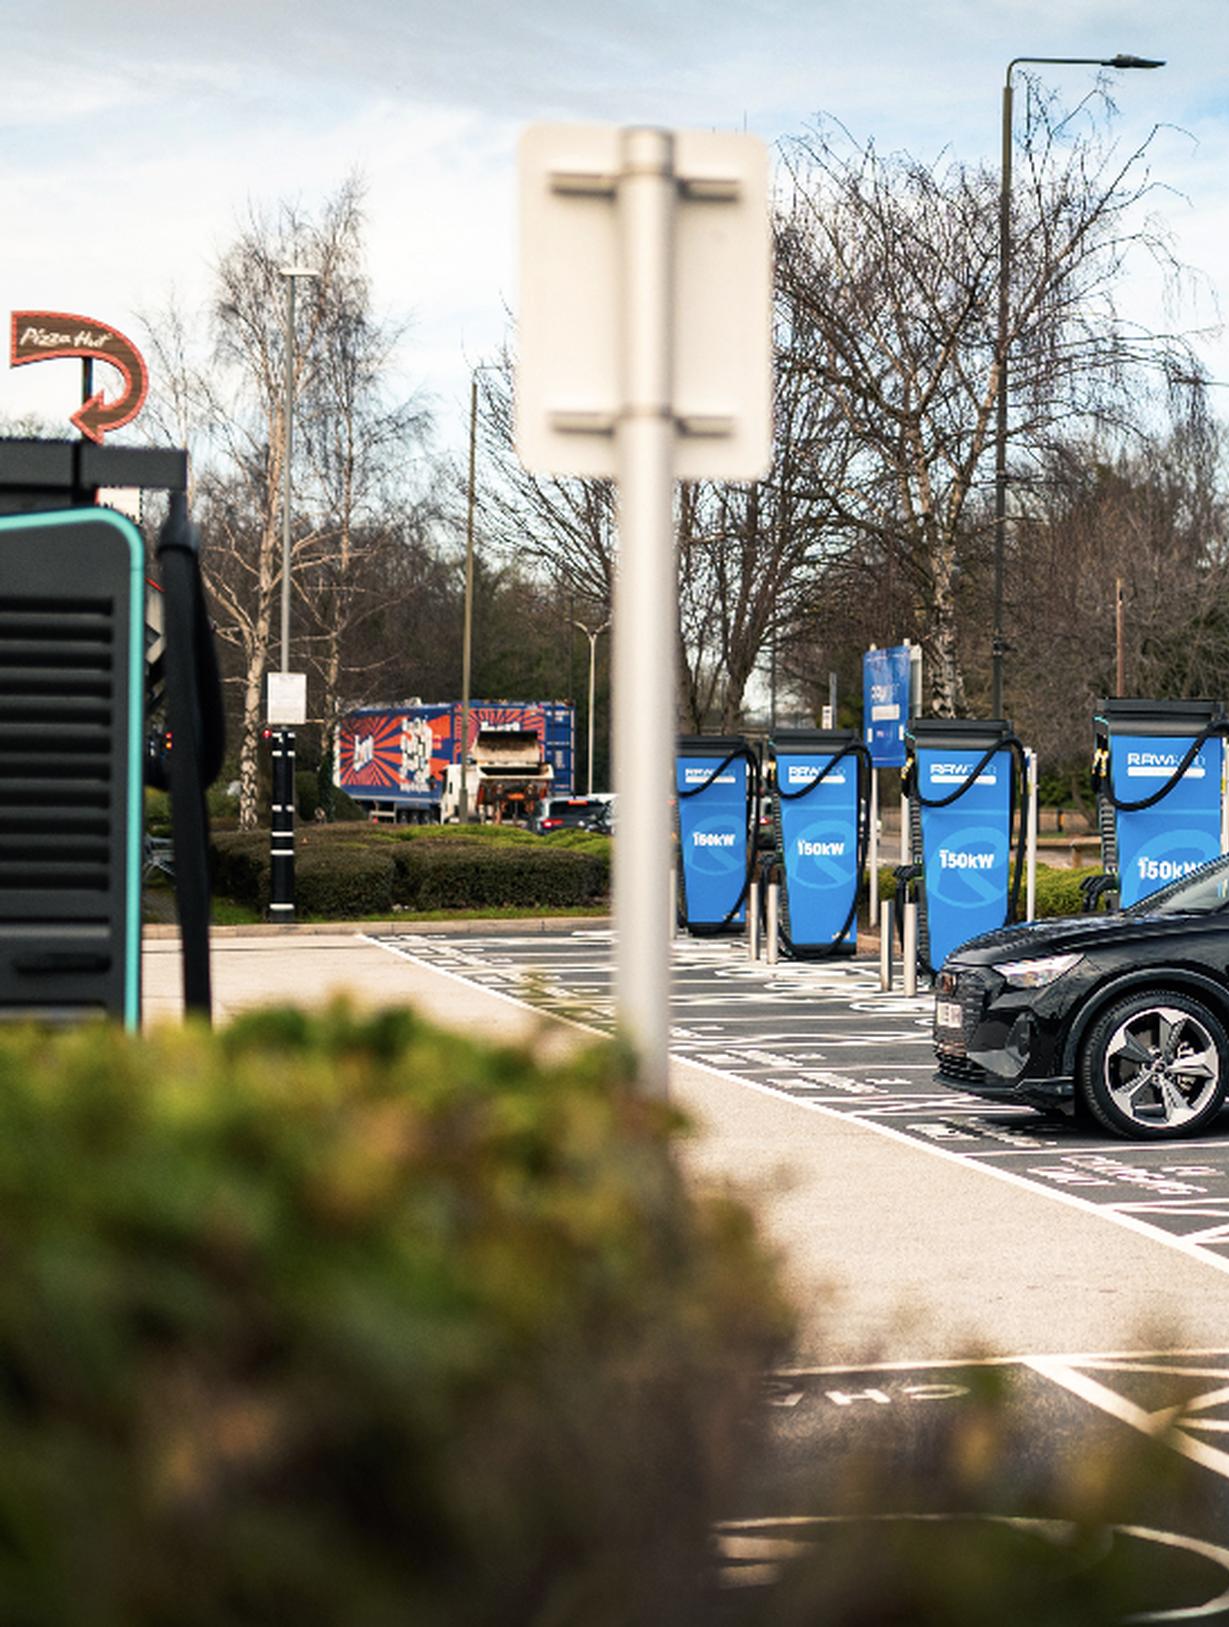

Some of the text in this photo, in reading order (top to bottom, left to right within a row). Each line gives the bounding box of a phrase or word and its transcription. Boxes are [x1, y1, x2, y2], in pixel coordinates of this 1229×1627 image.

[20, 327, 106, 347] Pizza Hut
[798, 841, 845, 856] 150kW
[939, 851, 995, 869] 150kW
